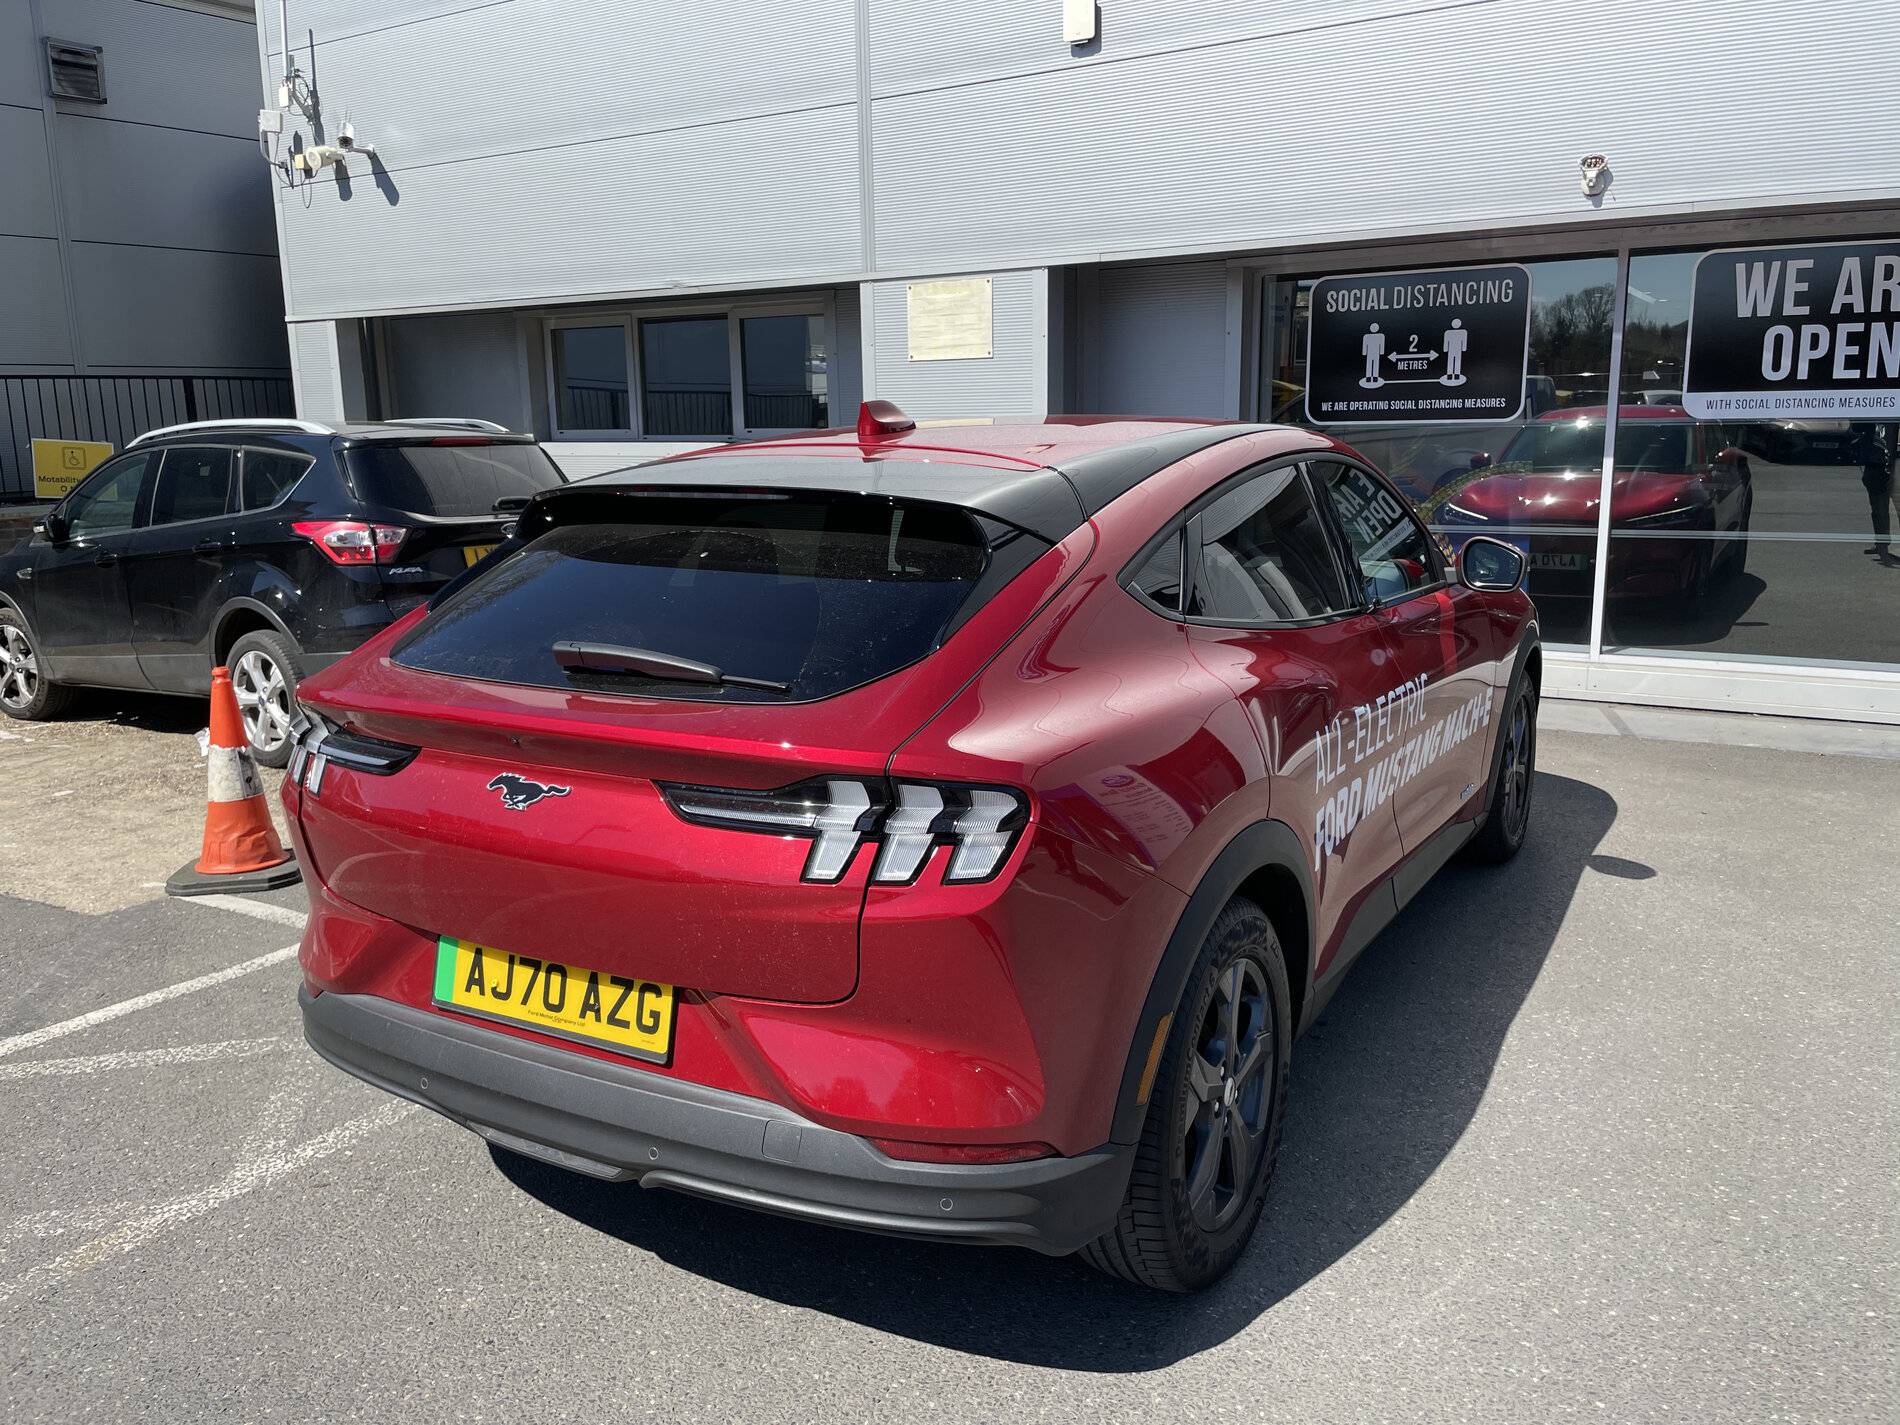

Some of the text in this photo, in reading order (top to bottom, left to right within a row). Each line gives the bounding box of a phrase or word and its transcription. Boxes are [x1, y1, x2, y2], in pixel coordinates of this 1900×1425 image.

[1326, 279, 1514, 313] SOCIAL DISTANCING
[1735, 254, 1900, 318] WE AR
[1397, 360, 1428, 370] METRES
[1408, 334, 1418, 352] 2
[1761, 321, 1900, 381] OPEN
[1321, 398, 1506, 411] WE ARE OPERATING SOCIAL DISTANCING MEASURES
[1706, 396, 1896, 410] WITH SOCIAL DISTANCING MEASURES
[1315, 673, 1428, 794] ALL-ELECTRIC
[1314, 686, 1493, 871] FORD MUSTANG MACH-E
[465, 947, 663, 1035] AJ70 AZG
